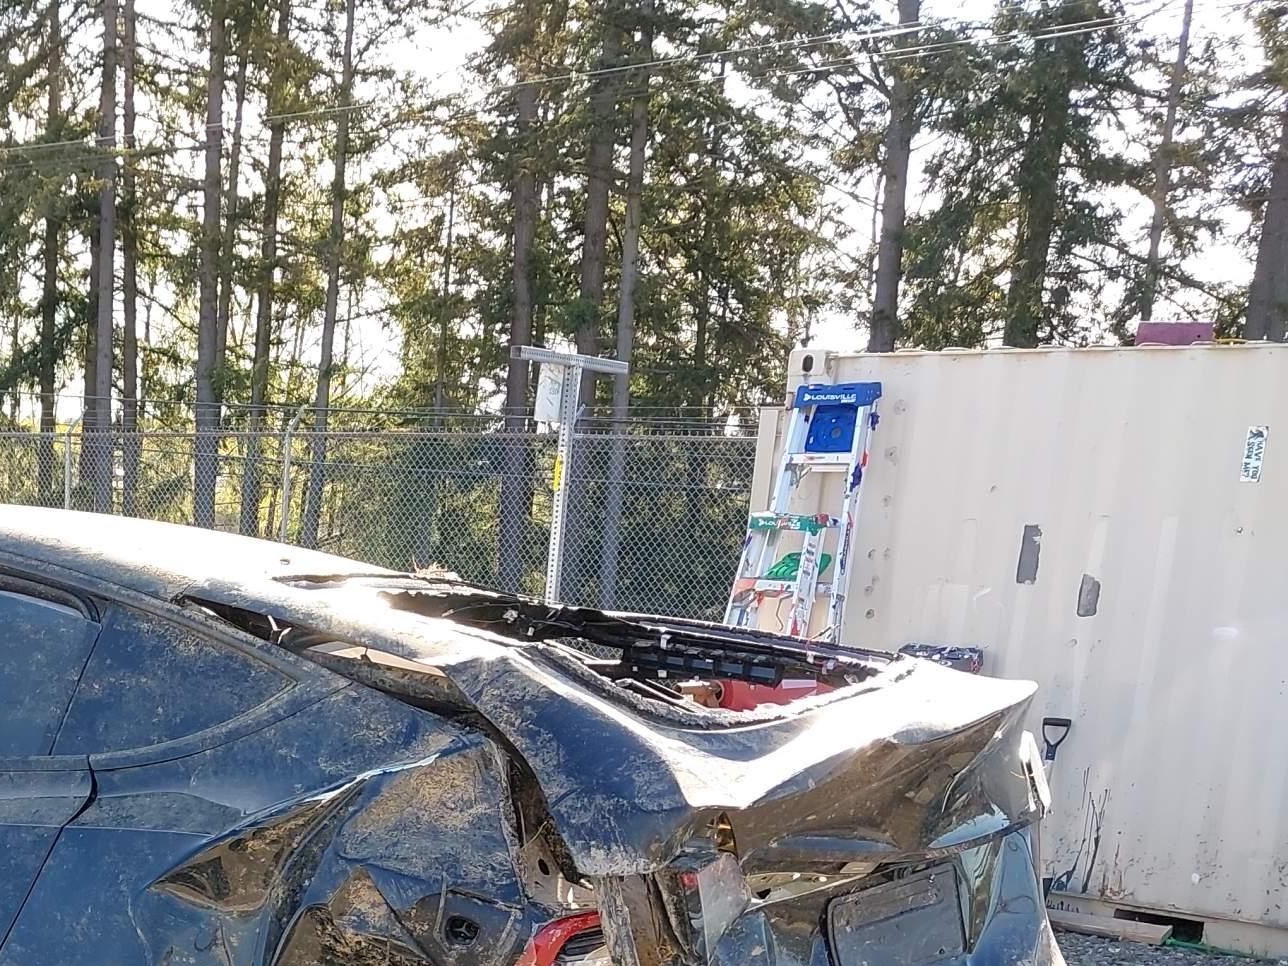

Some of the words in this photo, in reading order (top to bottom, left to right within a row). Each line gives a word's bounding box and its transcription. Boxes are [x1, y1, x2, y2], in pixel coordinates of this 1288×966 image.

[811, 393, 857, 401] LOUISVILLE
[1254, 440, 1263, 461] HAVE
[1251, 465, 1259, 479] YOU
